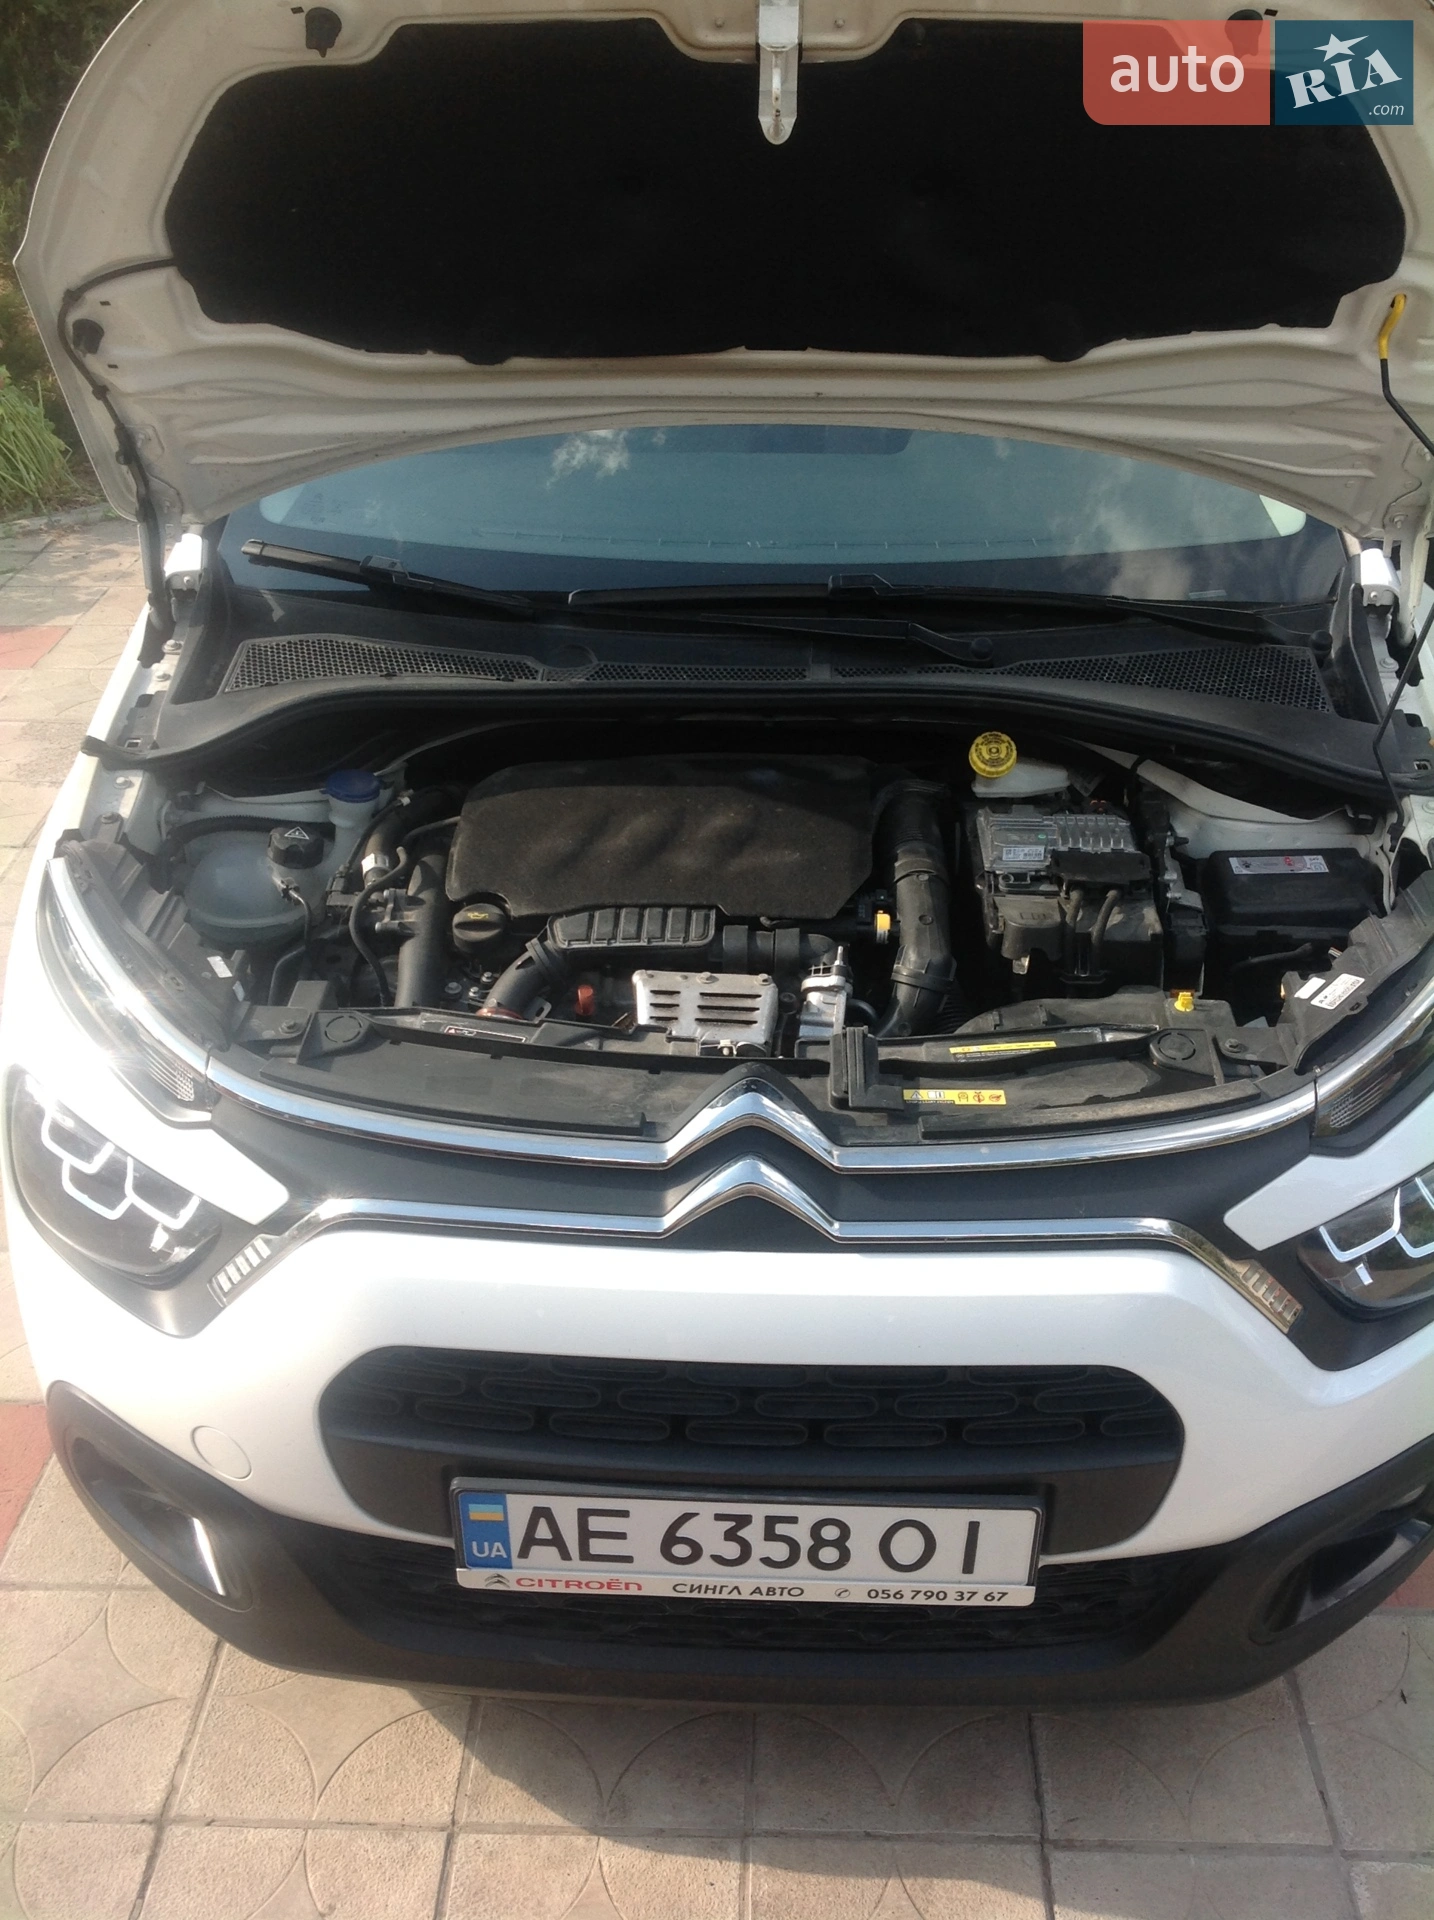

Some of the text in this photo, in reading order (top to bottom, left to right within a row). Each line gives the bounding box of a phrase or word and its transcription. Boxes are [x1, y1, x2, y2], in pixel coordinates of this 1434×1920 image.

[517, 1506, 634, 1564] AE
[659, 1512, 851, 1571] 6358
[472, 1540, 508, 1558] UA
[672, 1582, 805, 1597] СИНГЛ АВТО
[867, 1588, 1009, 1602] 056 790 37 67
